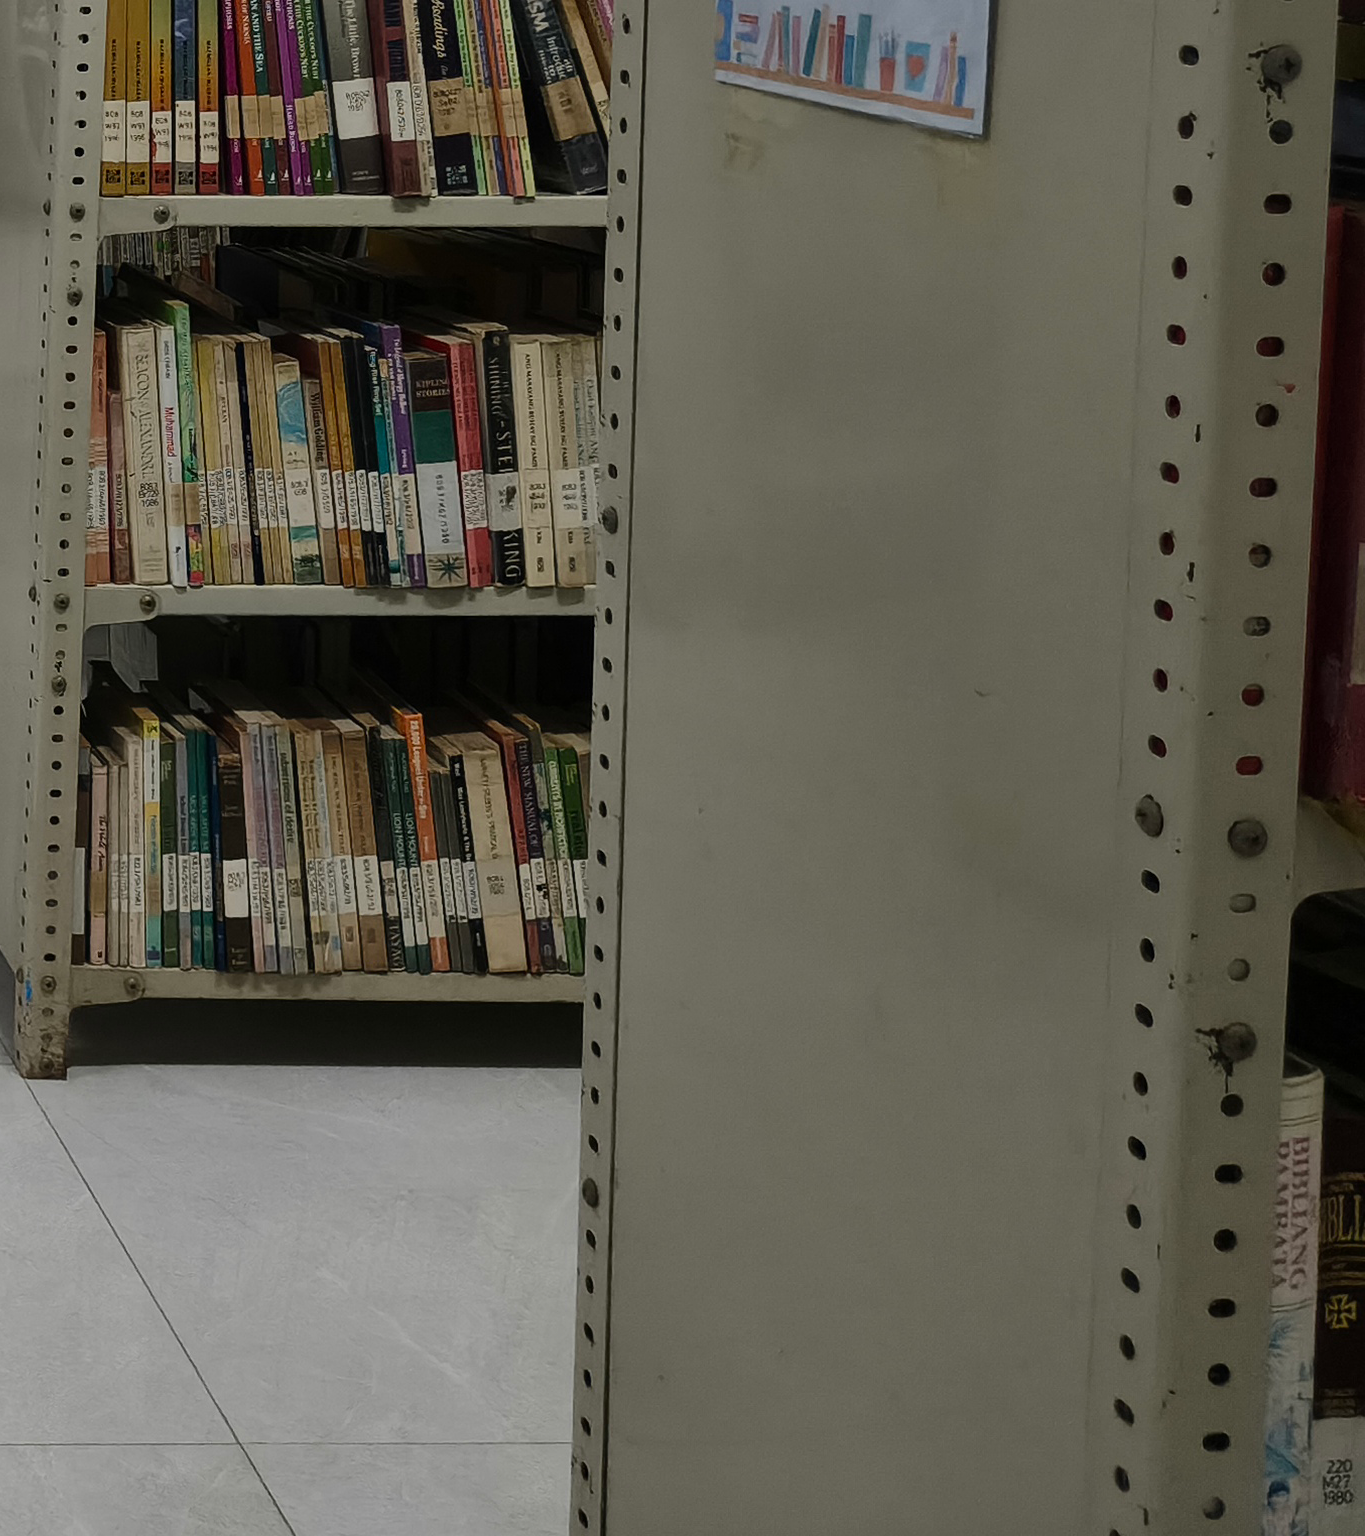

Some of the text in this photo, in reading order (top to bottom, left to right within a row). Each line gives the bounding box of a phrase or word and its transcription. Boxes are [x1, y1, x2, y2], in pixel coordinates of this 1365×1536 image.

[251, 10, 261, 31] AND
[253, 32, 262, 52] THE
[415, 388, 451, 398] STORIES
[488, 357, 502, 413] SHINING
[393, 812, 402, 832] LION
[405, 812, 416, 832] LION
[1288, 1135, 1312, 1291] BIBLIANG
[1326, 1458, 1353, 1475] 220
[1323, 1489, 1355, 1507] 1980
